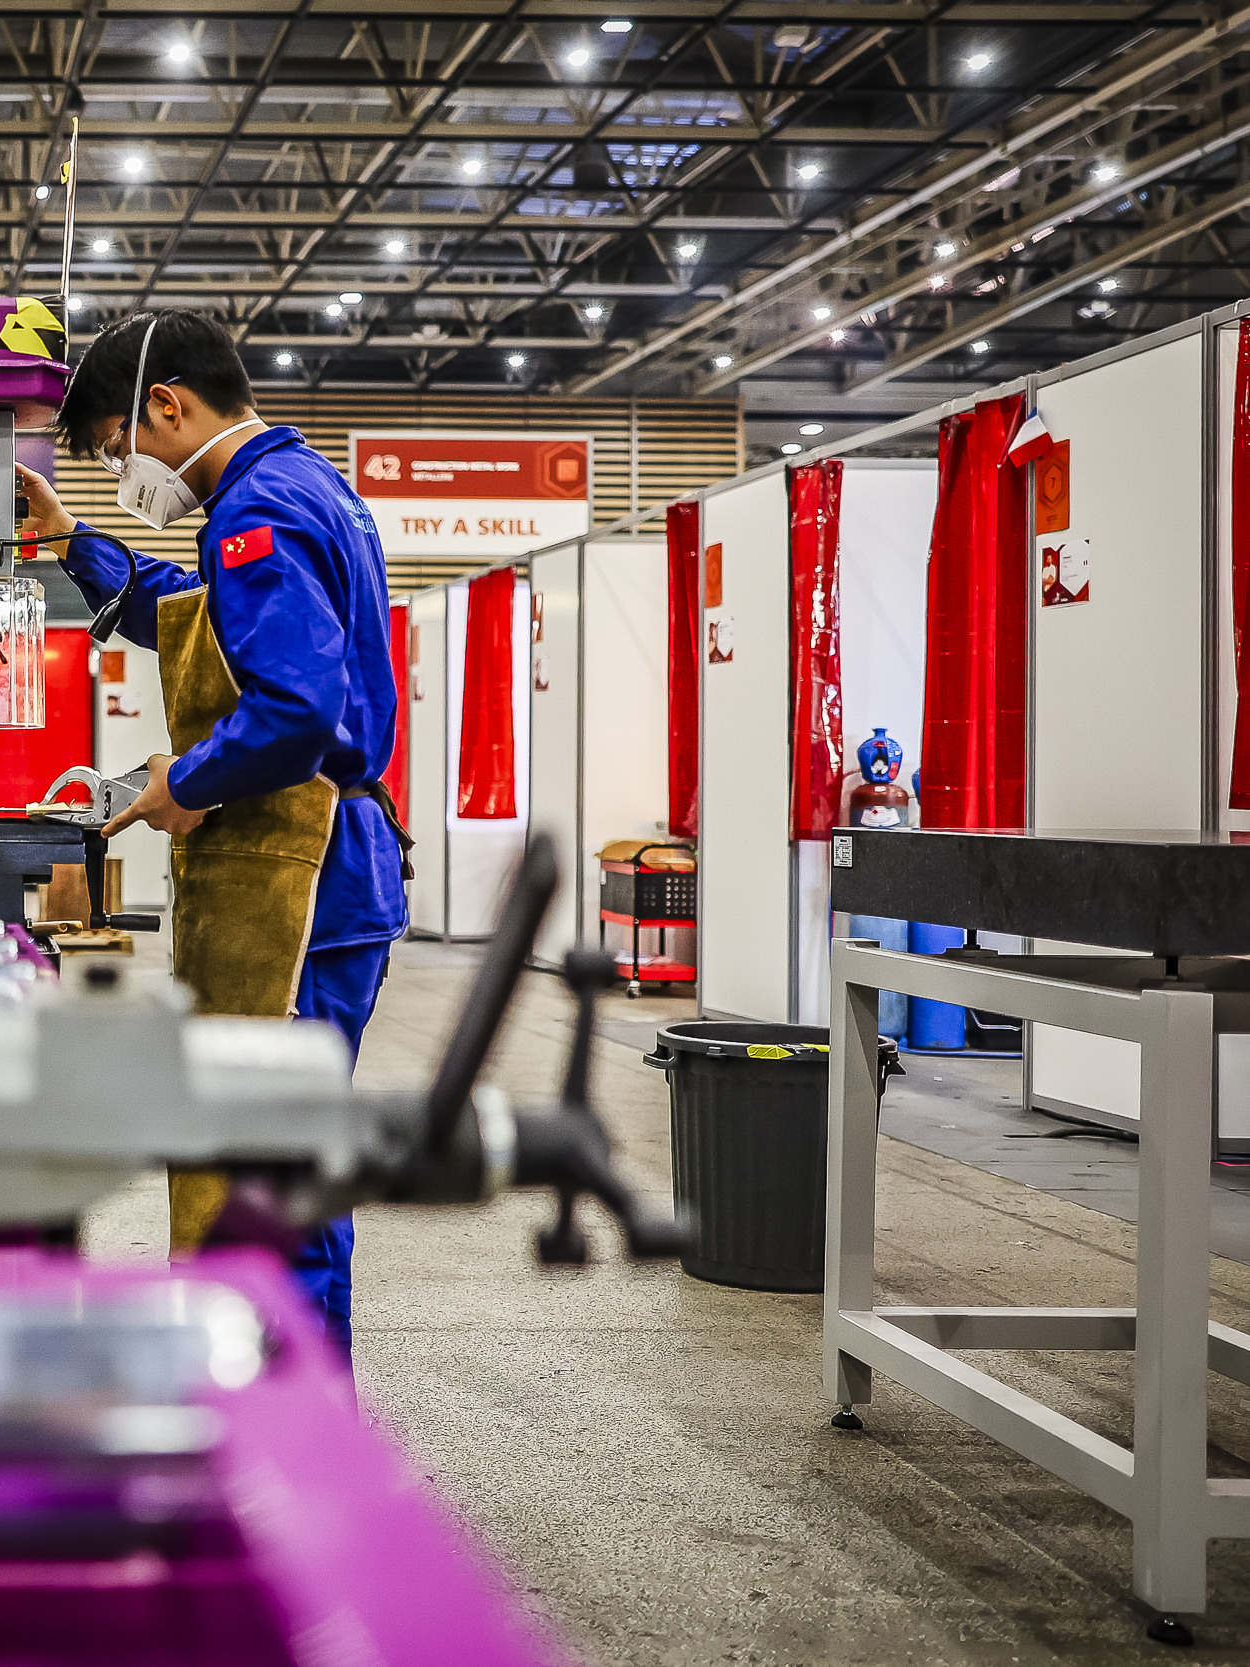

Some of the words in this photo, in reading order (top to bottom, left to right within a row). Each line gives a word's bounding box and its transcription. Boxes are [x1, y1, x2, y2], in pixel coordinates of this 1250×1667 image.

[363, 454, 402, 481] 42
[402, 518, 443, 535] TRY
[453, 519, 468, 536] A
[478, 518, 541, 536] SKILL
